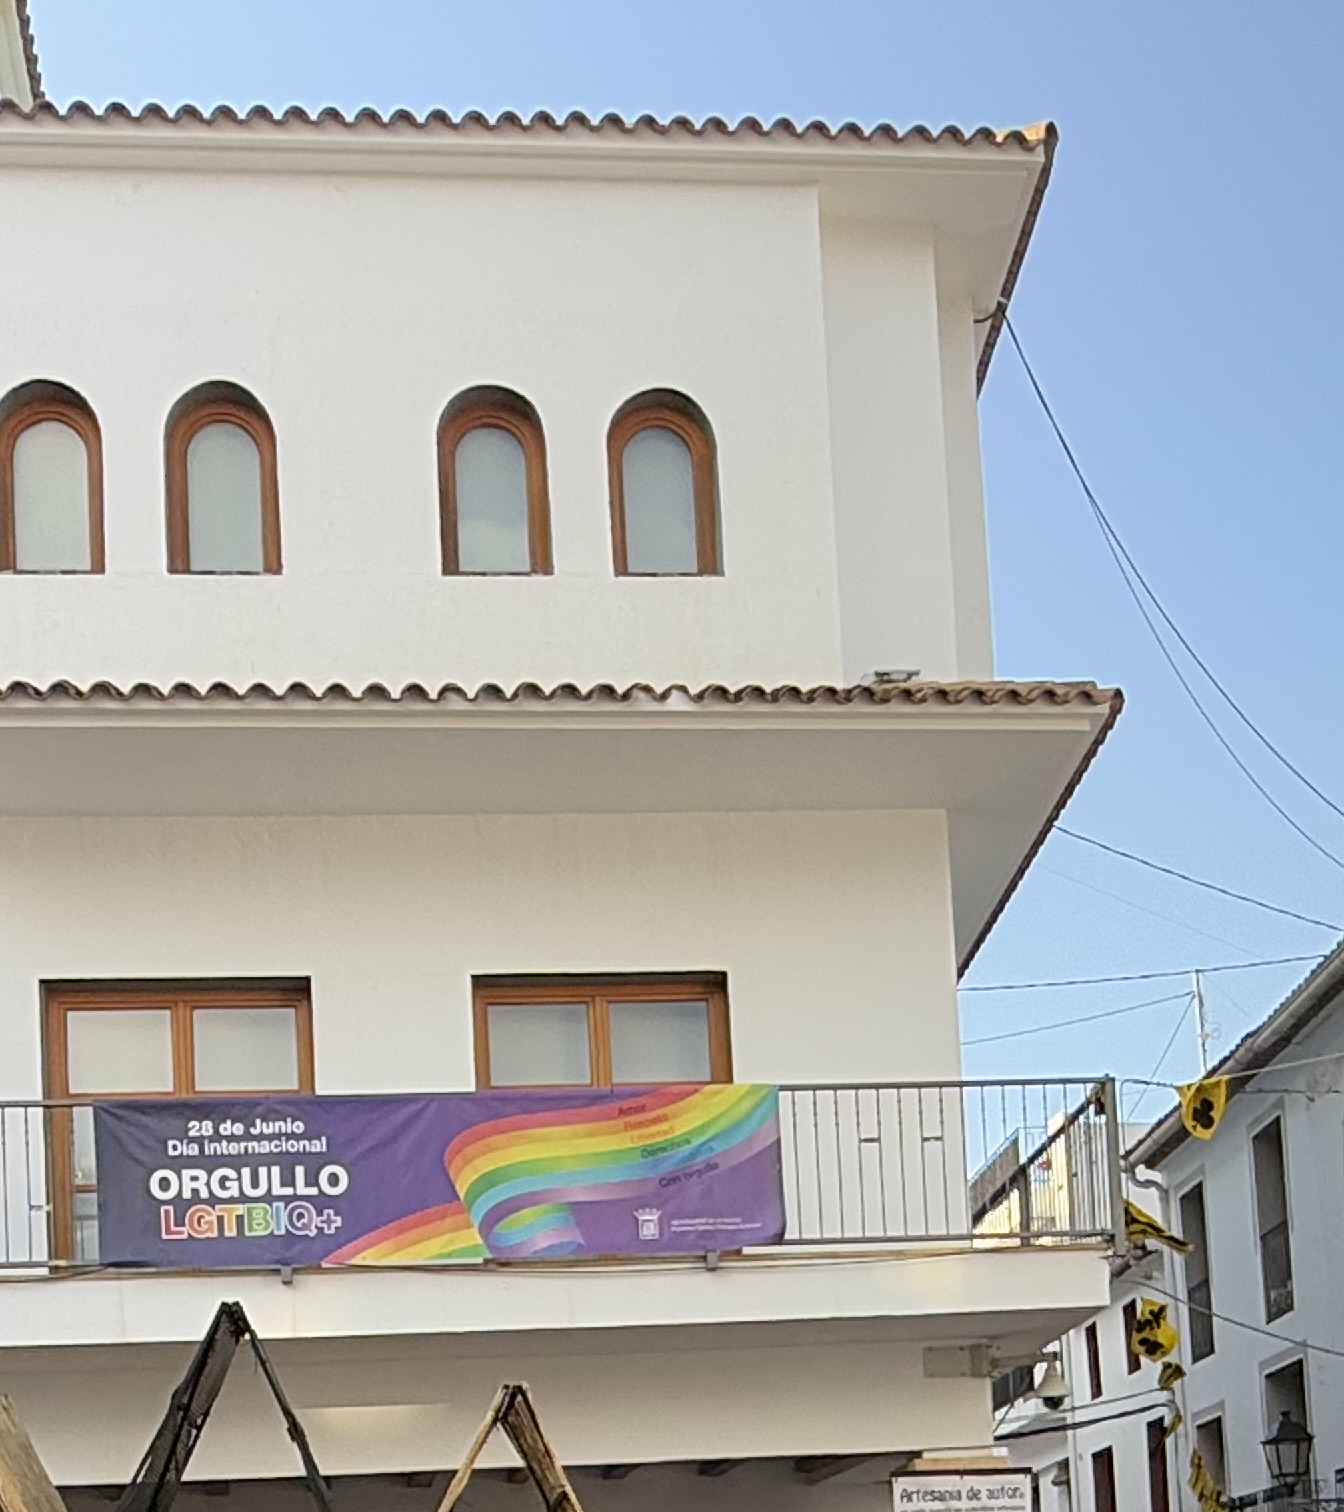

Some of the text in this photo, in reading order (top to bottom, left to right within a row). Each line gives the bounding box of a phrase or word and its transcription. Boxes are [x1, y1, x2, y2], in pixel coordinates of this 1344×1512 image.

[187, 1117, 305, 1137] 28 de Junio
[149, 1164, 349, 1200] ORGULLO
[160, 1201, 342, 1240] LGTBIQ+
[966, 1486, 982, 1501] de
